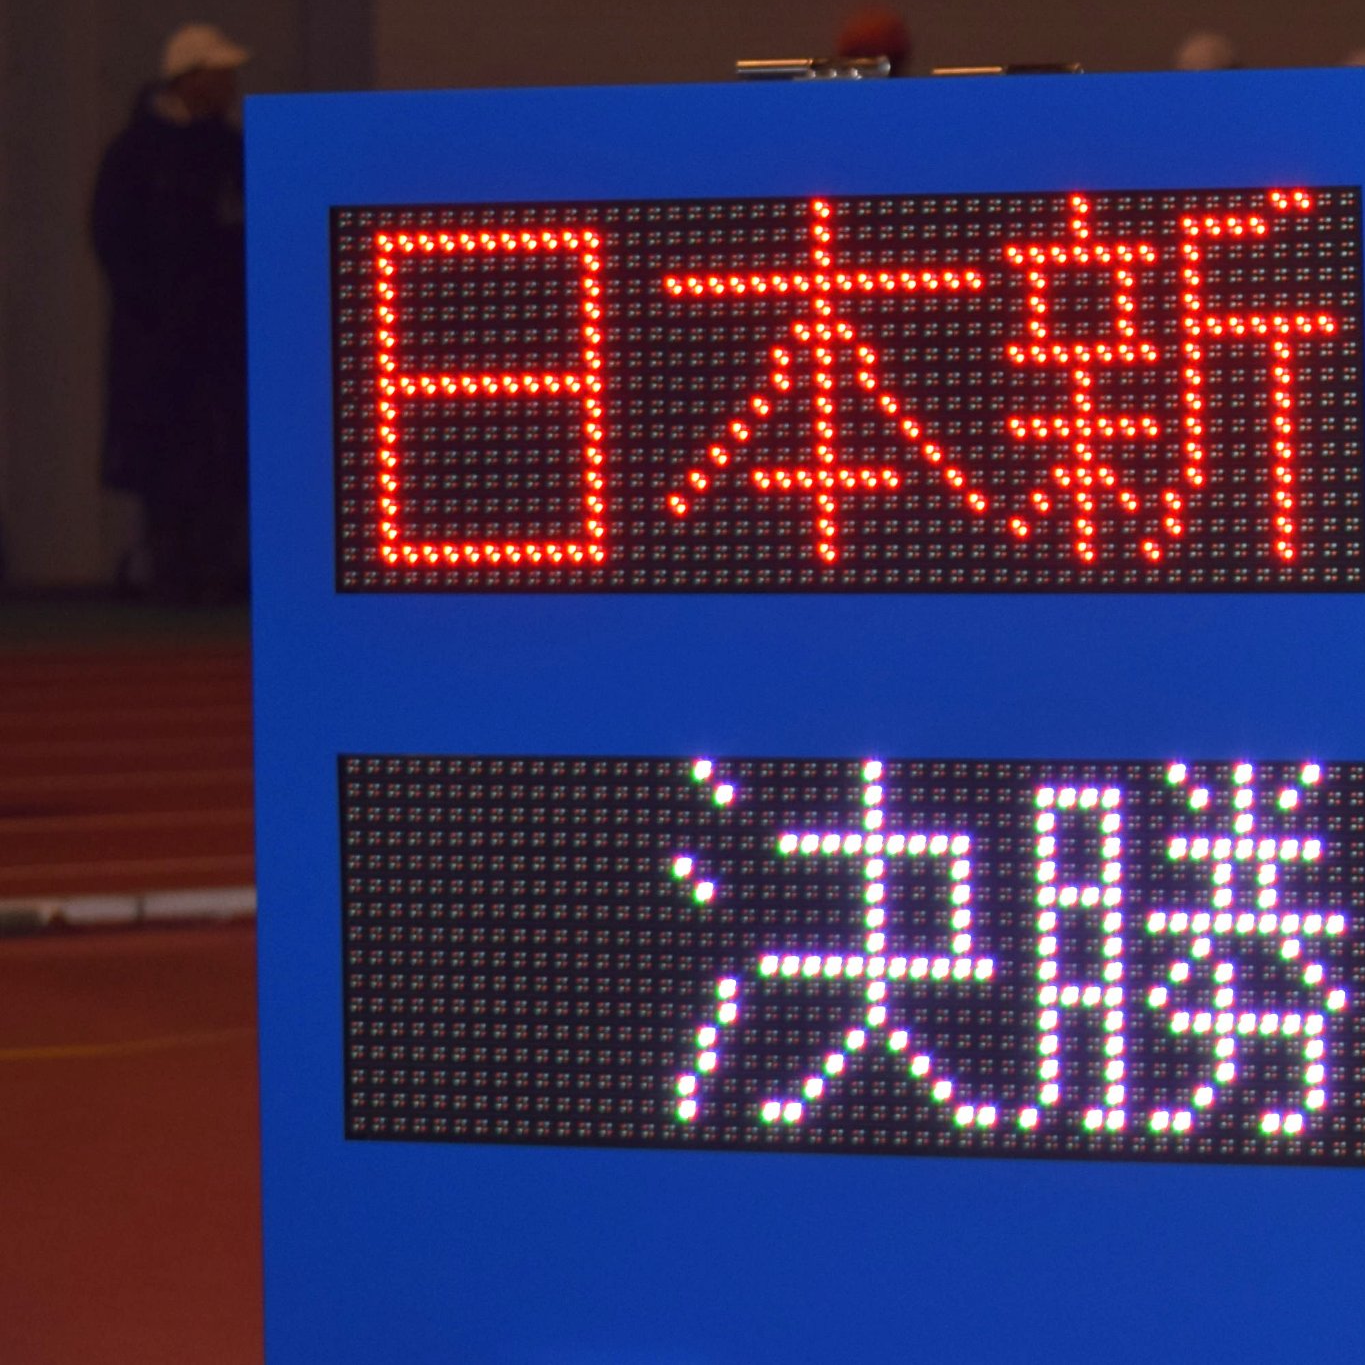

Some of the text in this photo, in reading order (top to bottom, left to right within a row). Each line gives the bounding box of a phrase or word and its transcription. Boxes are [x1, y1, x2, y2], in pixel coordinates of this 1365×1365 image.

[375, 189, 1340, 569] 日本新
[672, 758, 1350, 1134] 決勝
